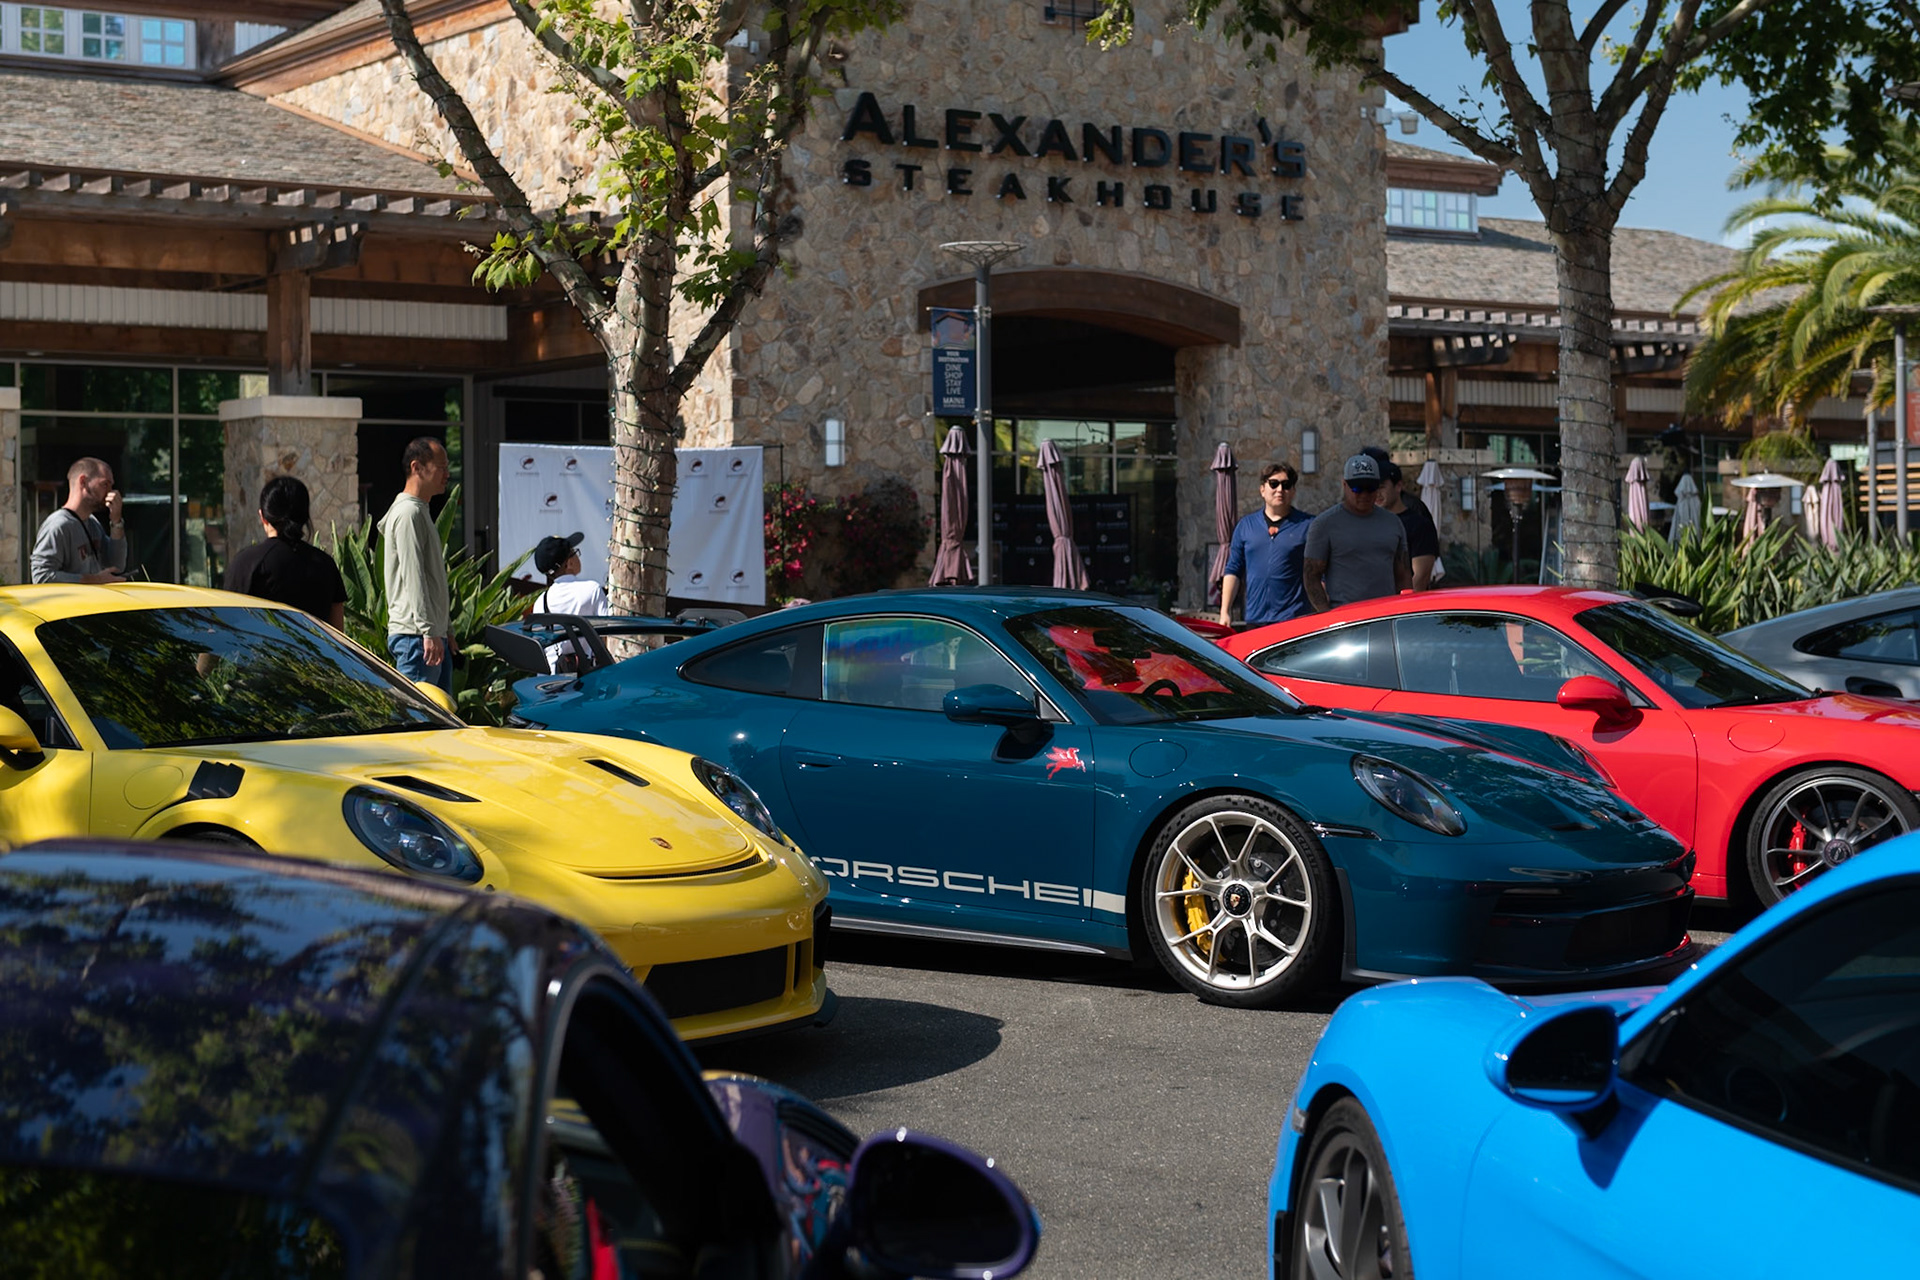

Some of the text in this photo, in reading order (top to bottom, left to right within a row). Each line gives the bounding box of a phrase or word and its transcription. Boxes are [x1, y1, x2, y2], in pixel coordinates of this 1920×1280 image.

[841, 91, 1306, 178] ALEXANDER'S
[843, 159, 1305, 221] STEAKHOUSE
[945, 363, 961, 371] DINE
[944, 371, 963, 379] SHOP
[945, 379, 962, 387] STAY
[946, 387, 961, 395] LIVE
[810, 856, 1080, 905] ORSCHE
